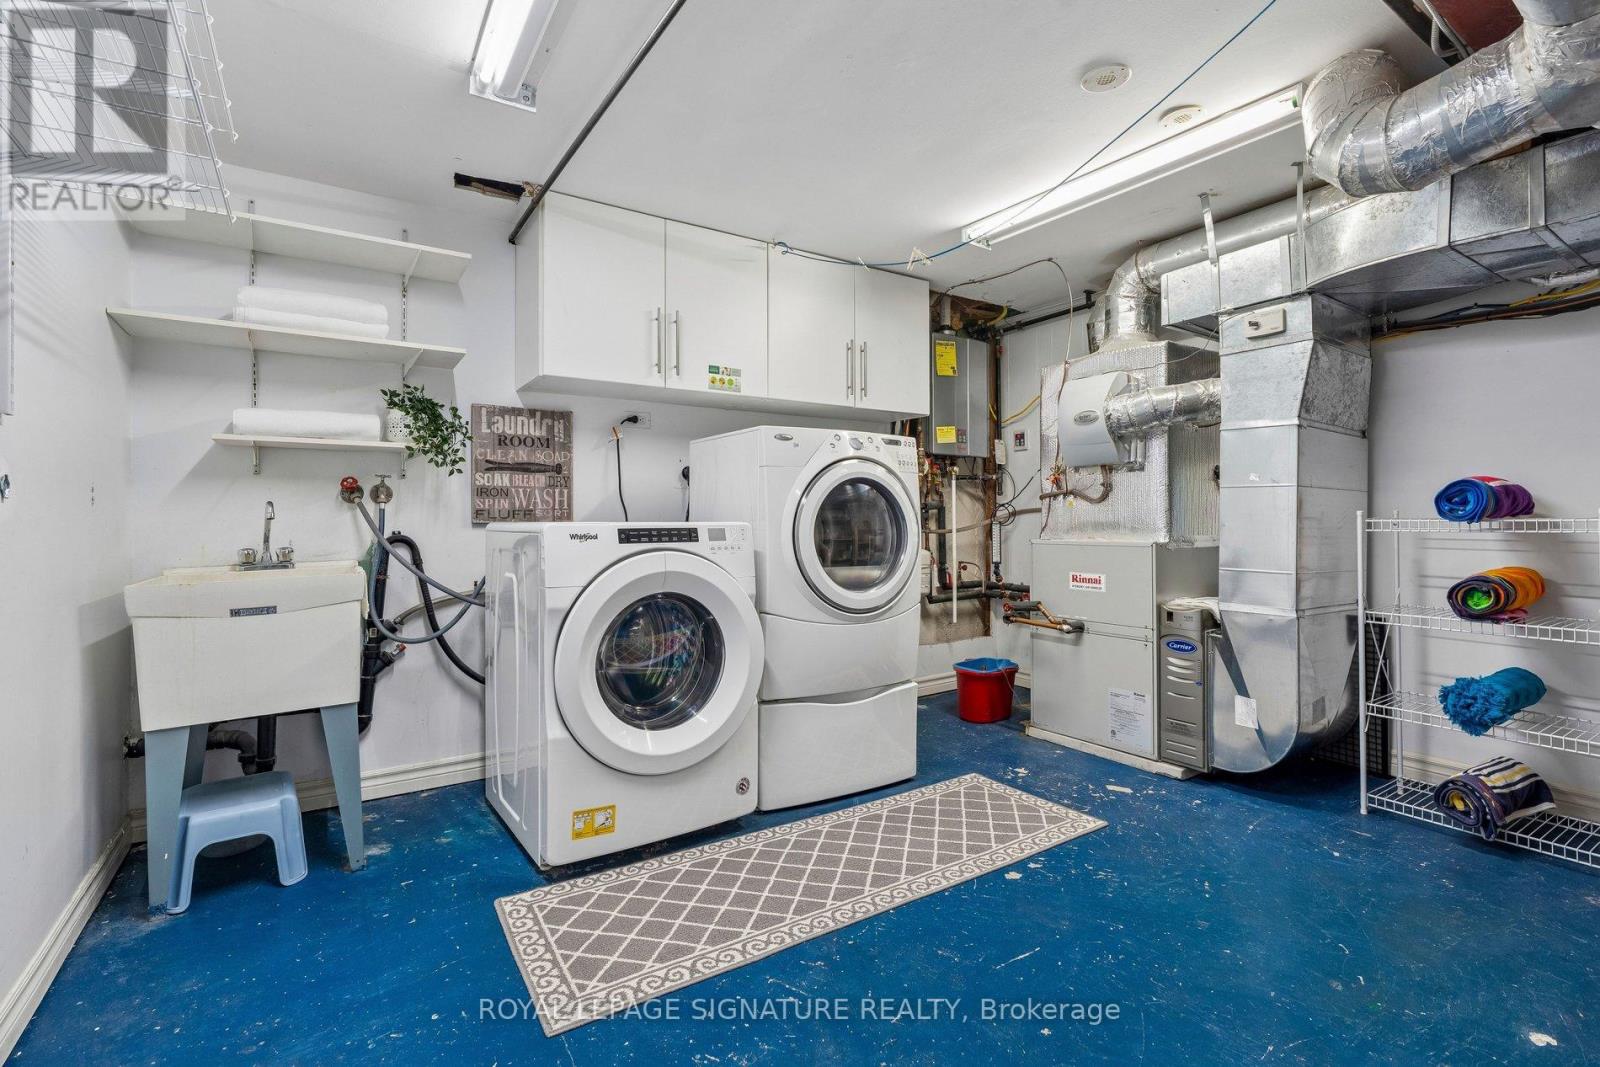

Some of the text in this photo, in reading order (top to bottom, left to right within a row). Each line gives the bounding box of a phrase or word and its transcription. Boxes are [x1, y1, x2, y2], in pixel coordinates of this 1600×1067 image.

[481, 407, 564, 442] Laundry
[497, 435, 550, 448] ROOM
[476, 447, 528, 462] CLEAN
[475, 472, 569, 488] SOAK BLEACH DRY
[476, 487, 509, 498] IRON
[512, 488, 568, 509] WASH
[475, 498, 509, 509] SPIN
[475, 509, 569, 519] FLUFF SORT
[569, 532, 598, 542] Whirlpool
[1071, 574, 1102, 585] Rinnai
